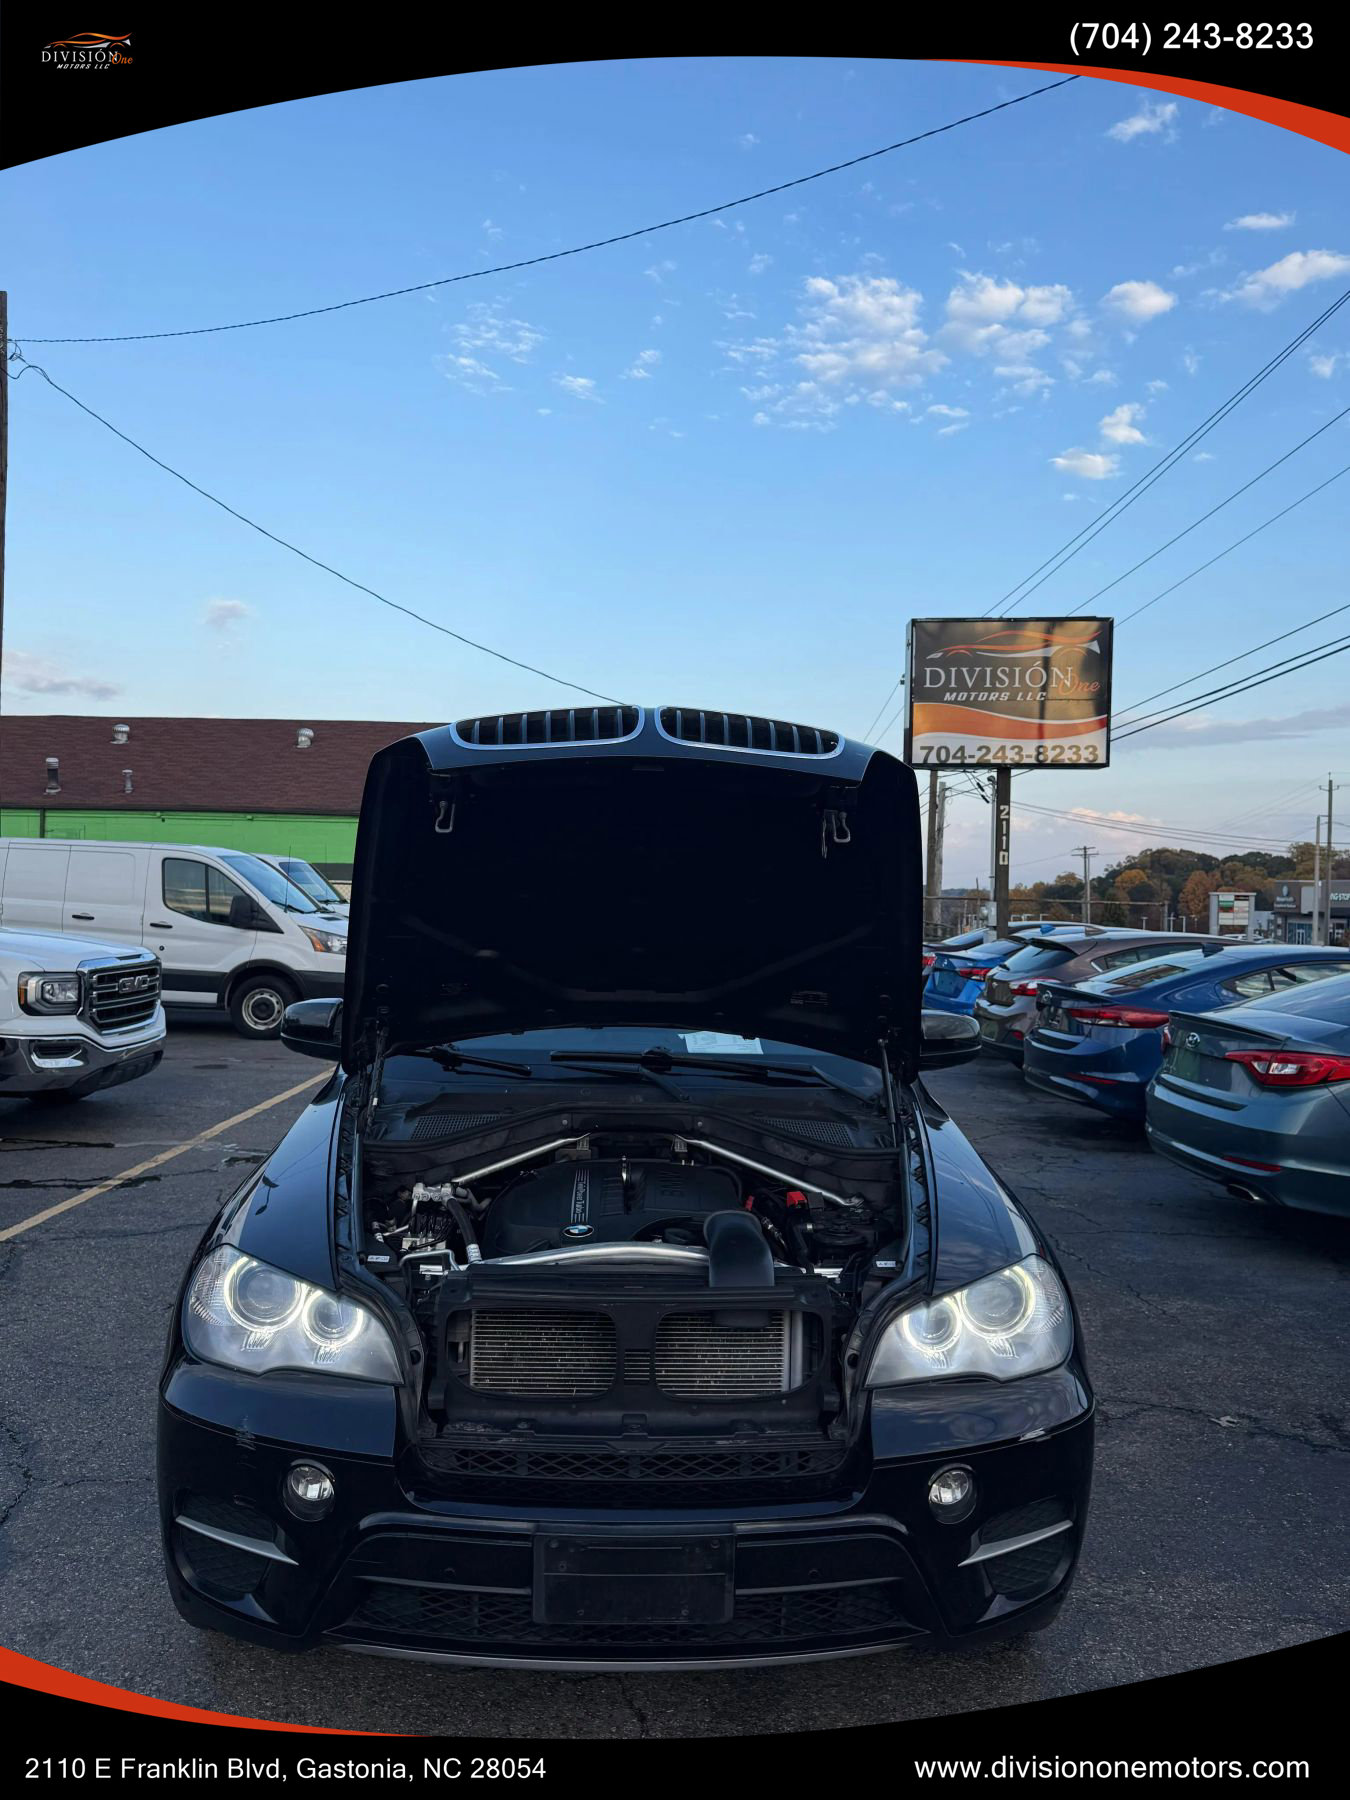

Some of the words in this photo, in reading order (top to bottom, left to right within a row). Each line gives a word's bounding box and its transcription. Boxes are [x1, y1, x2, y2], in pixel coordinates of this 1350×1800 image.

[1058, 671, 1101, 696] One
[943, 691, 1011, 702] MOTORS
[1015, 690, 1048, 702] LLC
[919, 744, 1099, 764] 704-243-8233
[998, 805, 1010, 866] 2110
[118, 974, 150, 994] GMC
